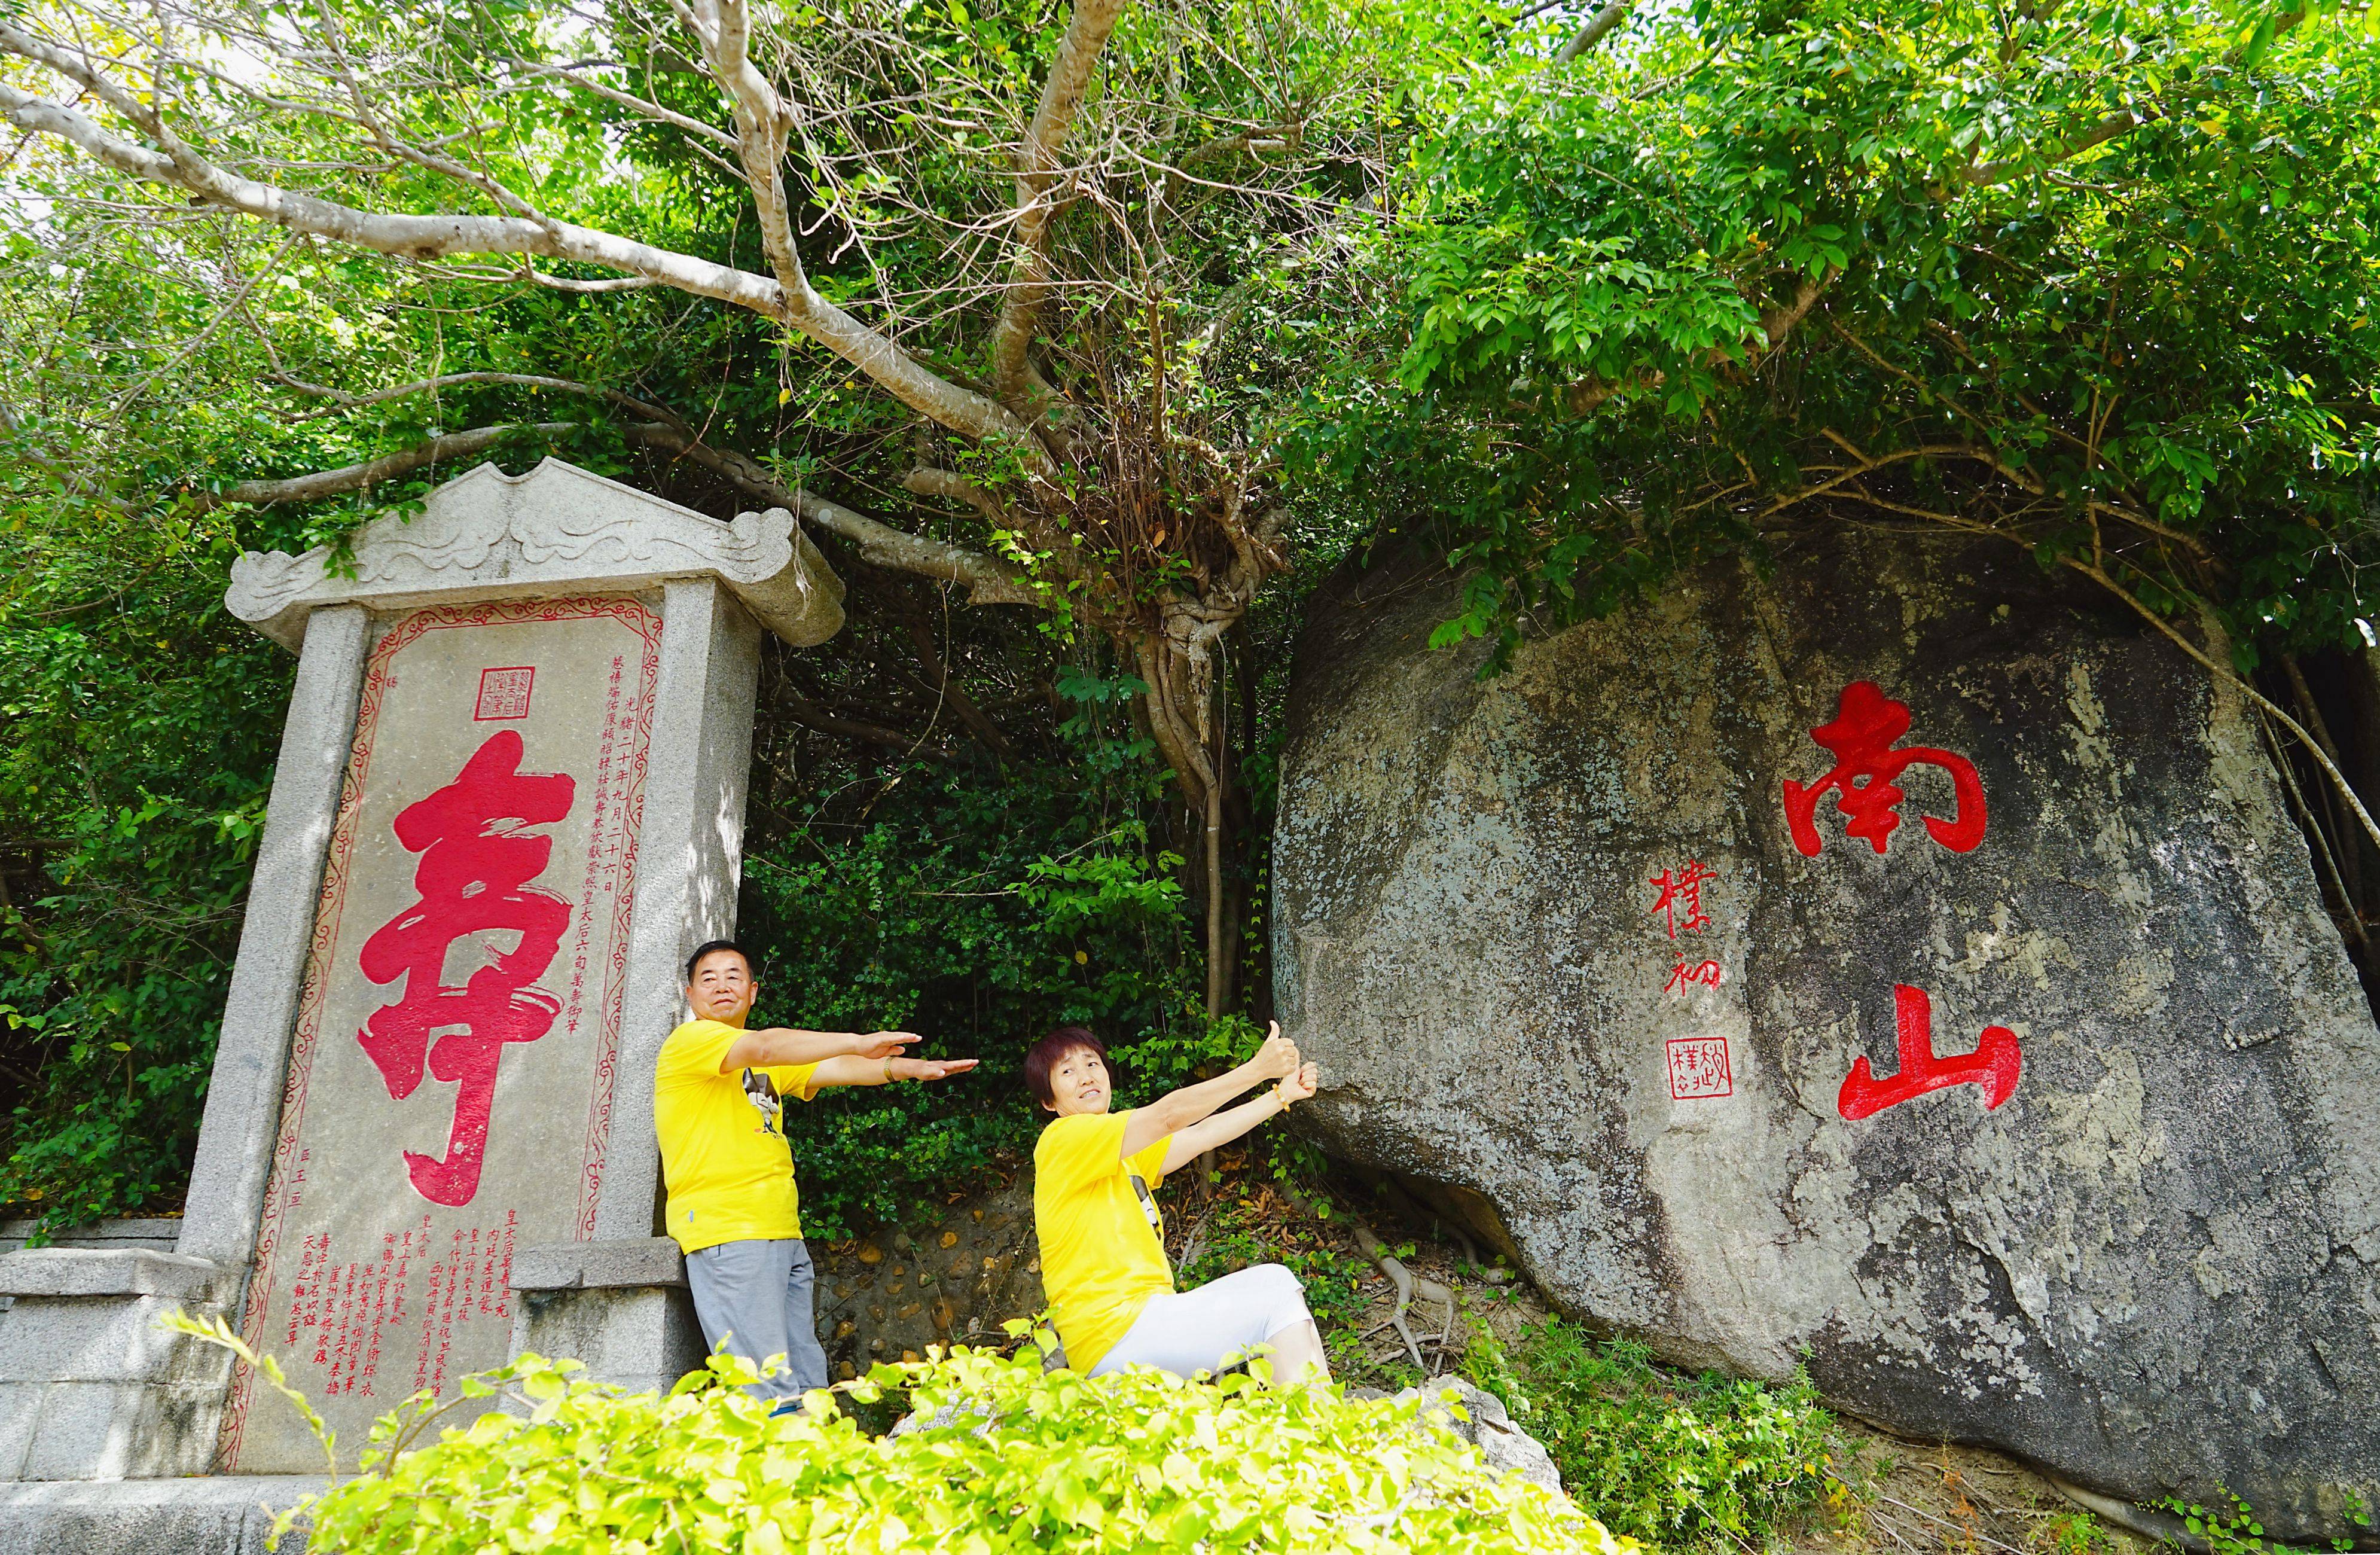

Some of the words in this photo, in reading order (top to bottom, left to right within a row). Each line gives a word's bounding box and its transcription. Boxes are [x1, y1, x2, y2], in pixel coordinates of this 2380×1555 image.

[603, 697, 639, 892] 光緒二十年九月二十六日
[1783, 681, 2022, 1121] 南山
